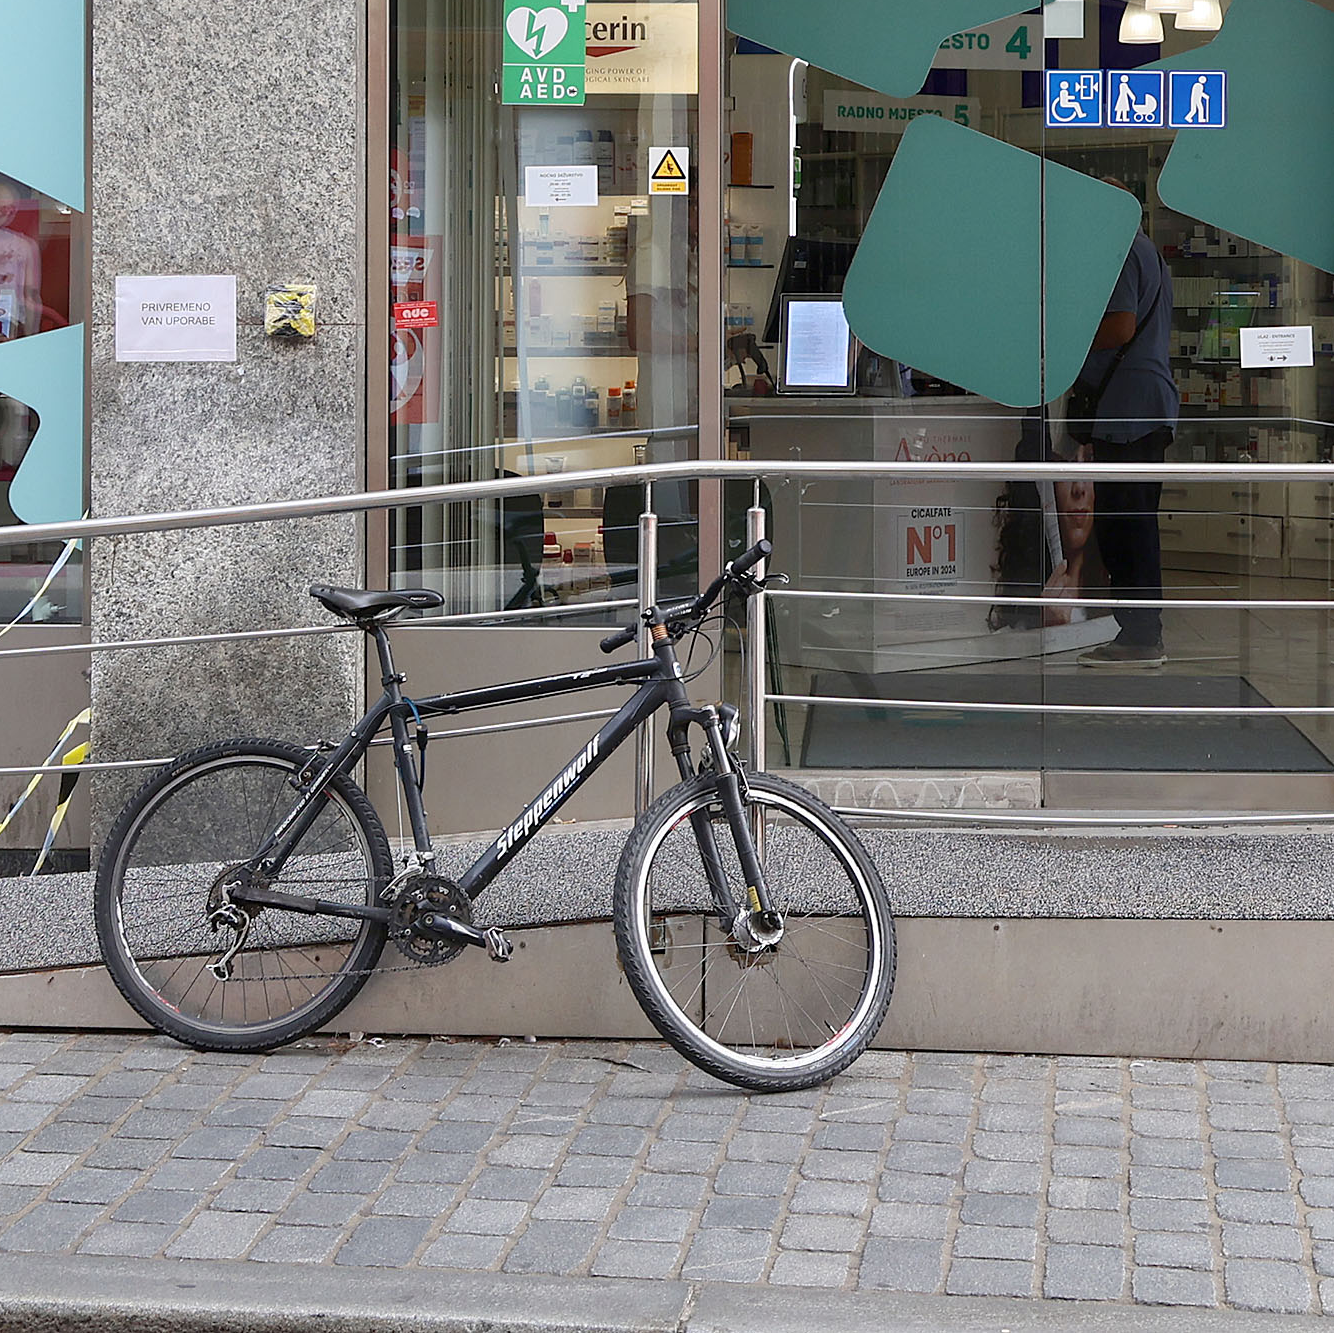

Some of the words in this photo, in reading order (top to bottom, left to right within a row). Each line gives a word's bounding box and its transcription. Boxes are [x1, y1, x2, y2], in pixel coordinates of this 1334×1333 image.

[1005, 25, 1031, 60] 4
[519, 67, 566, 83] AVD
[519, 83, 565, 99] AED
[837, 105, 884, 120] RADNO
[954, 104, 970, 127] 5
[141, 302, 211, 312] PRIVREMENO
[141, 316, 163, 326] VAN
[165, 316, 216, 326] UPORABE
[911, 507, 952, 519] CICALFATE
[906, 567, 931, 577] EUROPE
[931, 566, 940, 575] IN
[940, 565, 956, 575] 2024
[497, 733, 600, 860] Steppenwolf
